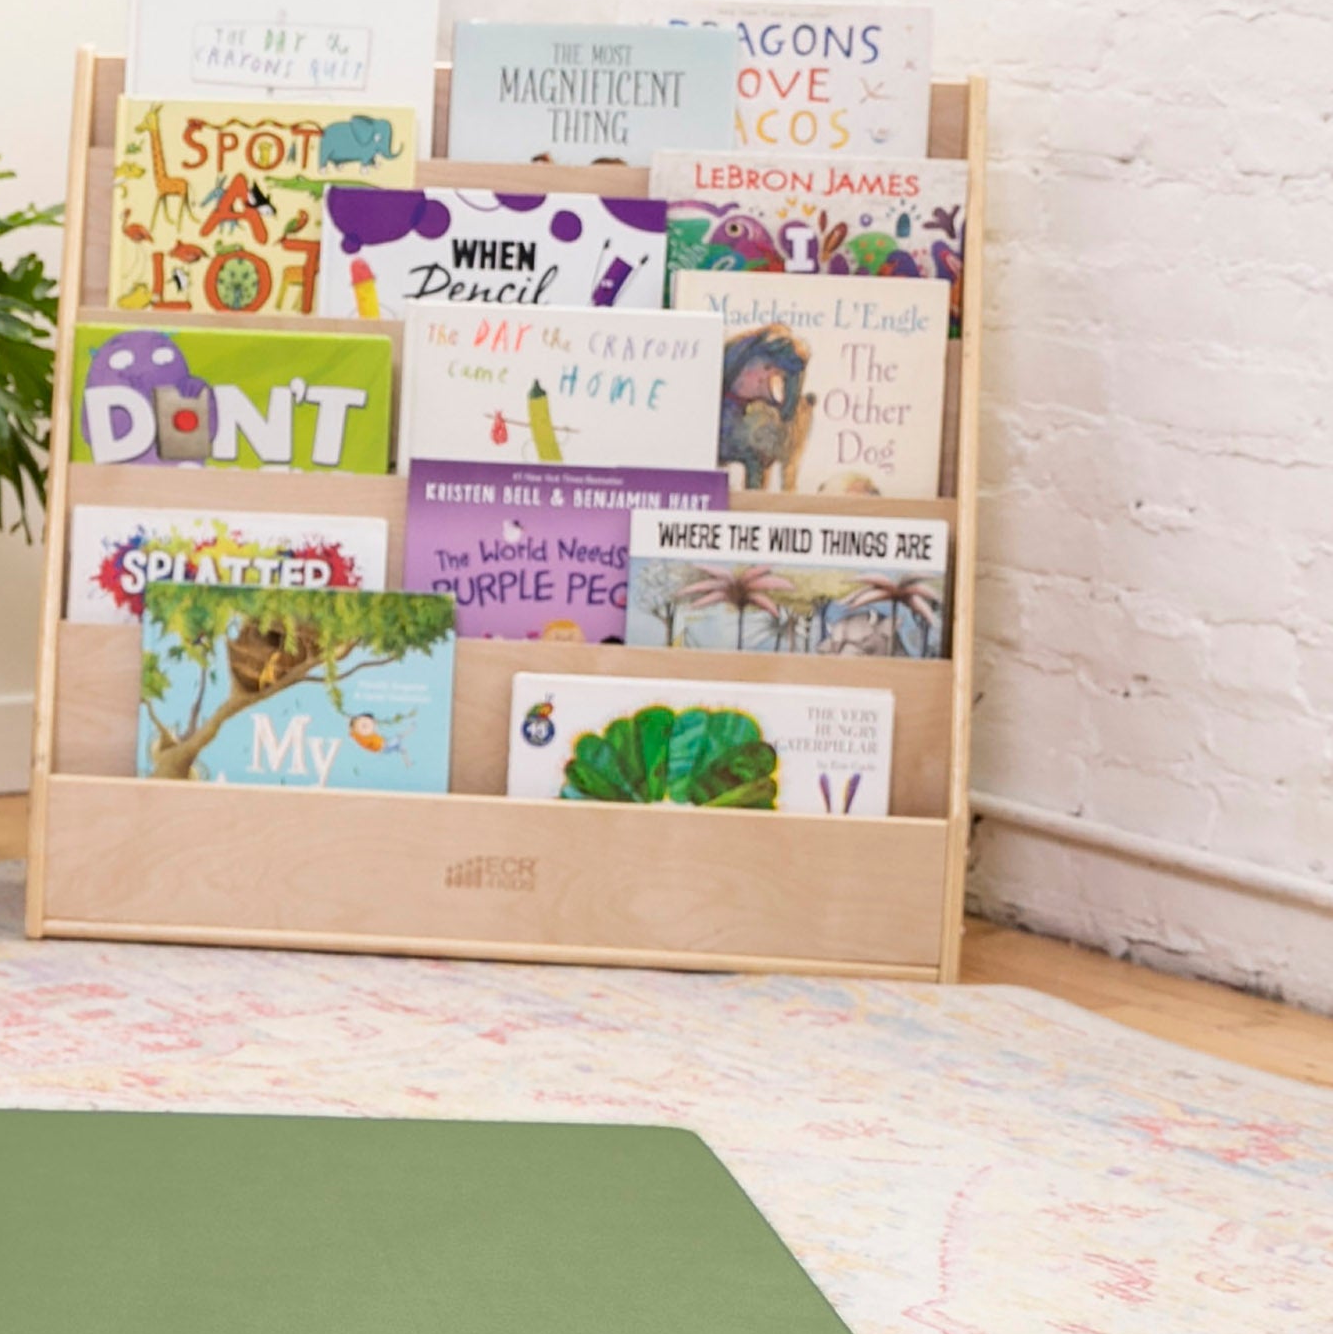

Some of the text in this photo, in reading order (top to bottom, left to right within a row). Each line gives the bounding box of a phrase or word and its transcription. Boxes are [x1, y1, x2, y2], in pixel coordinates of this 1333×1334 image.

[263, 28, 307, 53] DAY
[552, 43, 634, 66] THE MOST
[669, 19, 882, 64] AGONS
[194, 46, 294, 79] CRAYONS
[499, 67, 687, 108] MAGNIFICENT
[736, 67, 830, 103] OVE
[181, 119, 324, 173] SPOT
[547, 108, 630, 146] THING
[734, 107, 851, 150] ACOS
[823, 168, 921, 198] JAMES
[199, 173, 269, 244] A
[452, 239, 537, 271] WHEN
[785, 226, 815, 272] I
[151, 238, 322, 314] LOT
[708, 292, 930, 336] Madeleine L'Engle
[473, 318, 532, 353] DAY
[587, 330, 700, 361] CRAYONS
[840, 343, 899, 383] The
[559, 364, 667, 411] HOME
[823, 385, 912, 426] Other
[837, 428, 896, 475] Dog
[425, 481, 713, 511] KRISTEN BELL & BENJAMIN HART
[434, 537, 628, 572] The World Needs
[658, 521, 933, 560] WHERE THE WILD THINGS ARE
[566, 571, 628, 609] PEO
[245, 712, 344, 788] My
